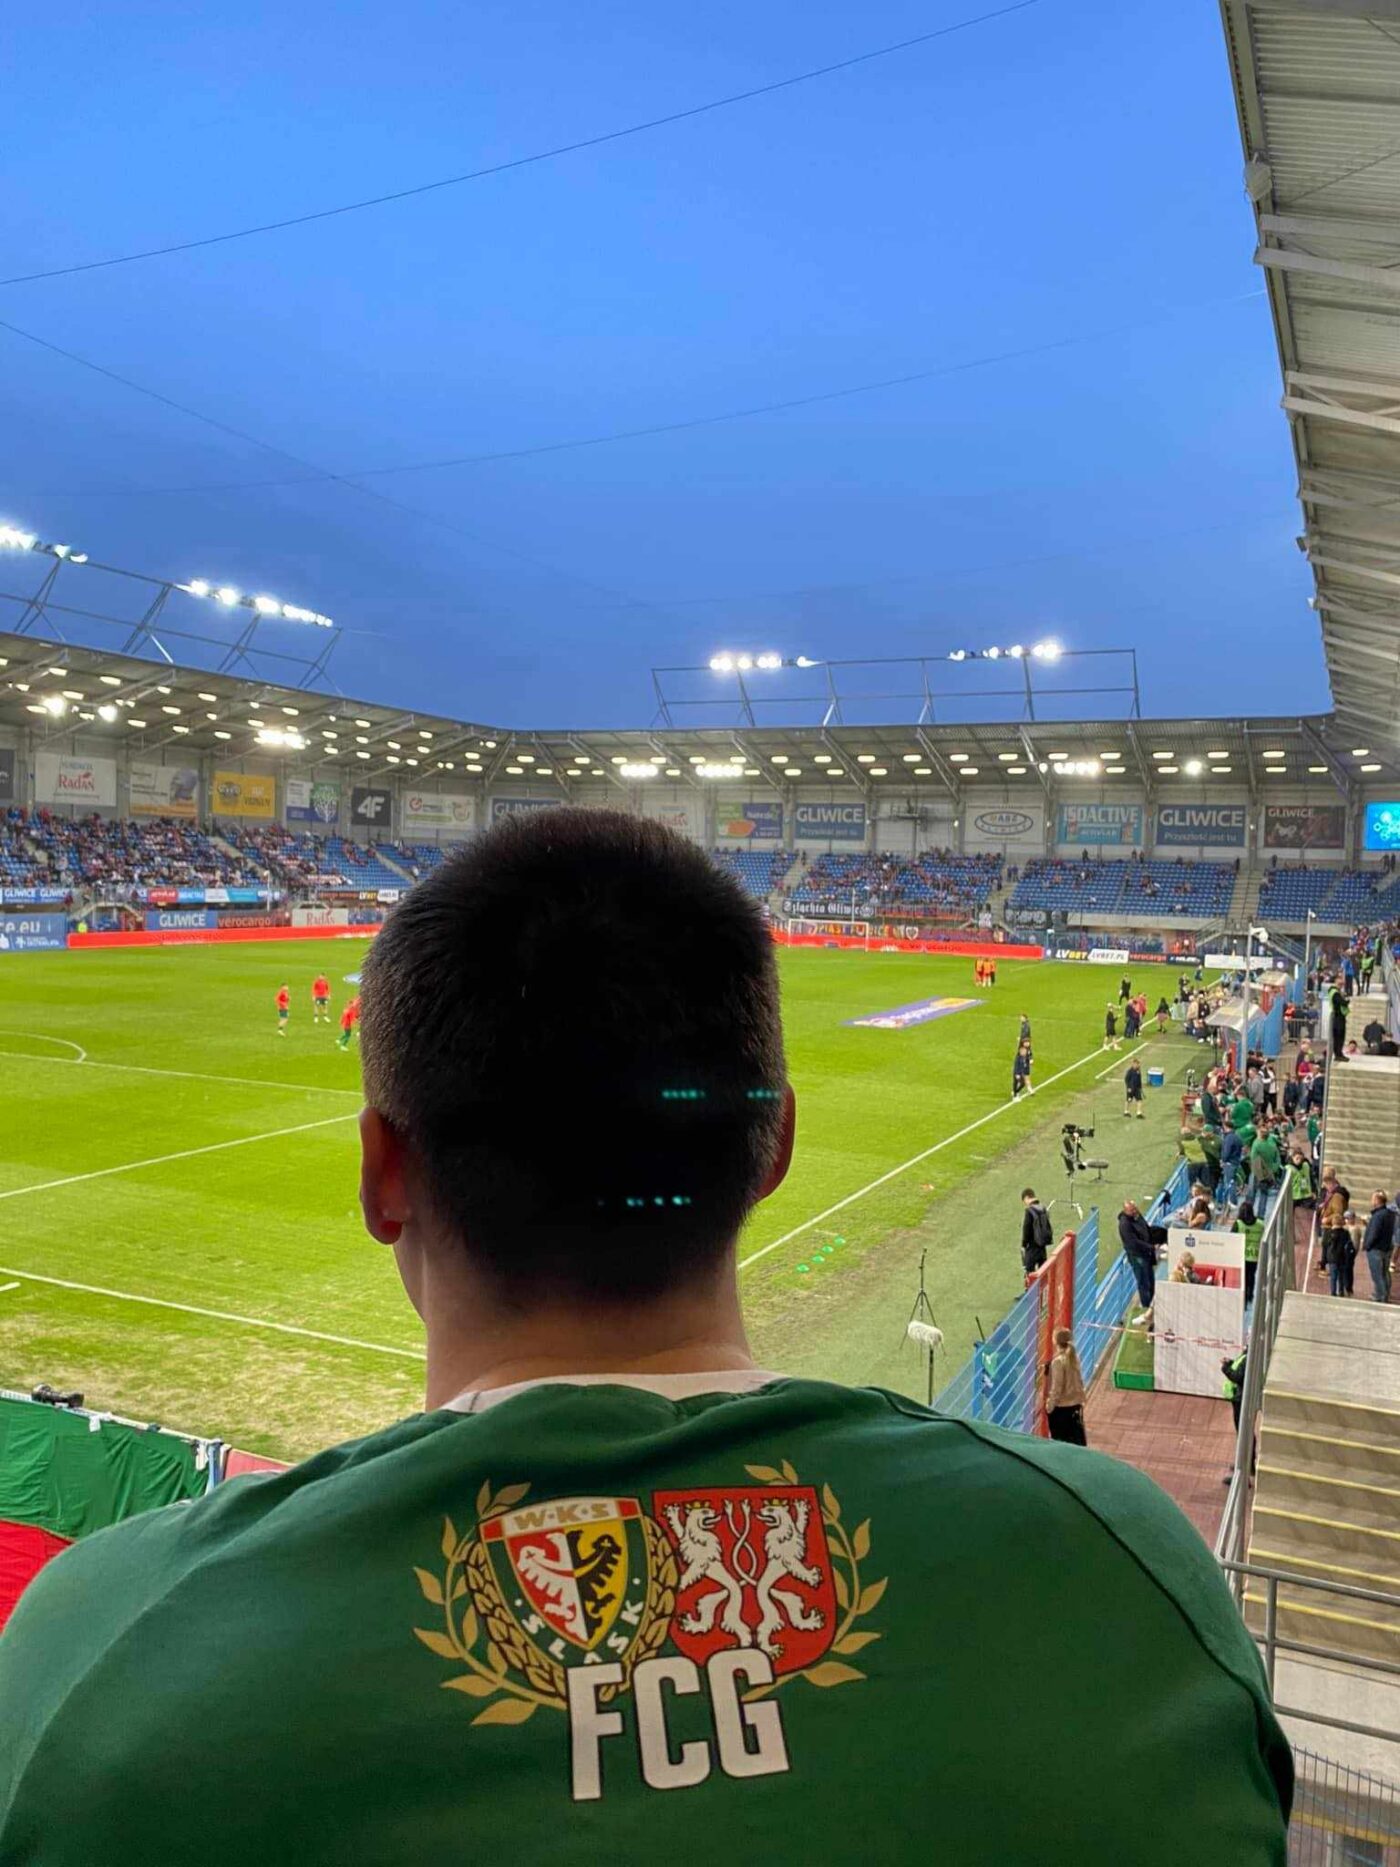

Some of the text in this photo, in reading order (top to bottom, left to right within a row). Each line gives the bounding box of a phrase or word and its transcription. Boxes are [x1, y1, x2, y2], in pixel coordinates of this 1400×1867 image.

[358, 796, 385, 818] 4F
[796, 807, 863, 823] GLIWICE
[1064, 806, 1139, 823] ISOACTIVE
[1160, 809, 1243, 827] GLIWICE
[160, 913, 206, 927] GLIWICE
[1056, 949, 1088, 960] LVBET
[567, 1647, 790, 1802] FCG
